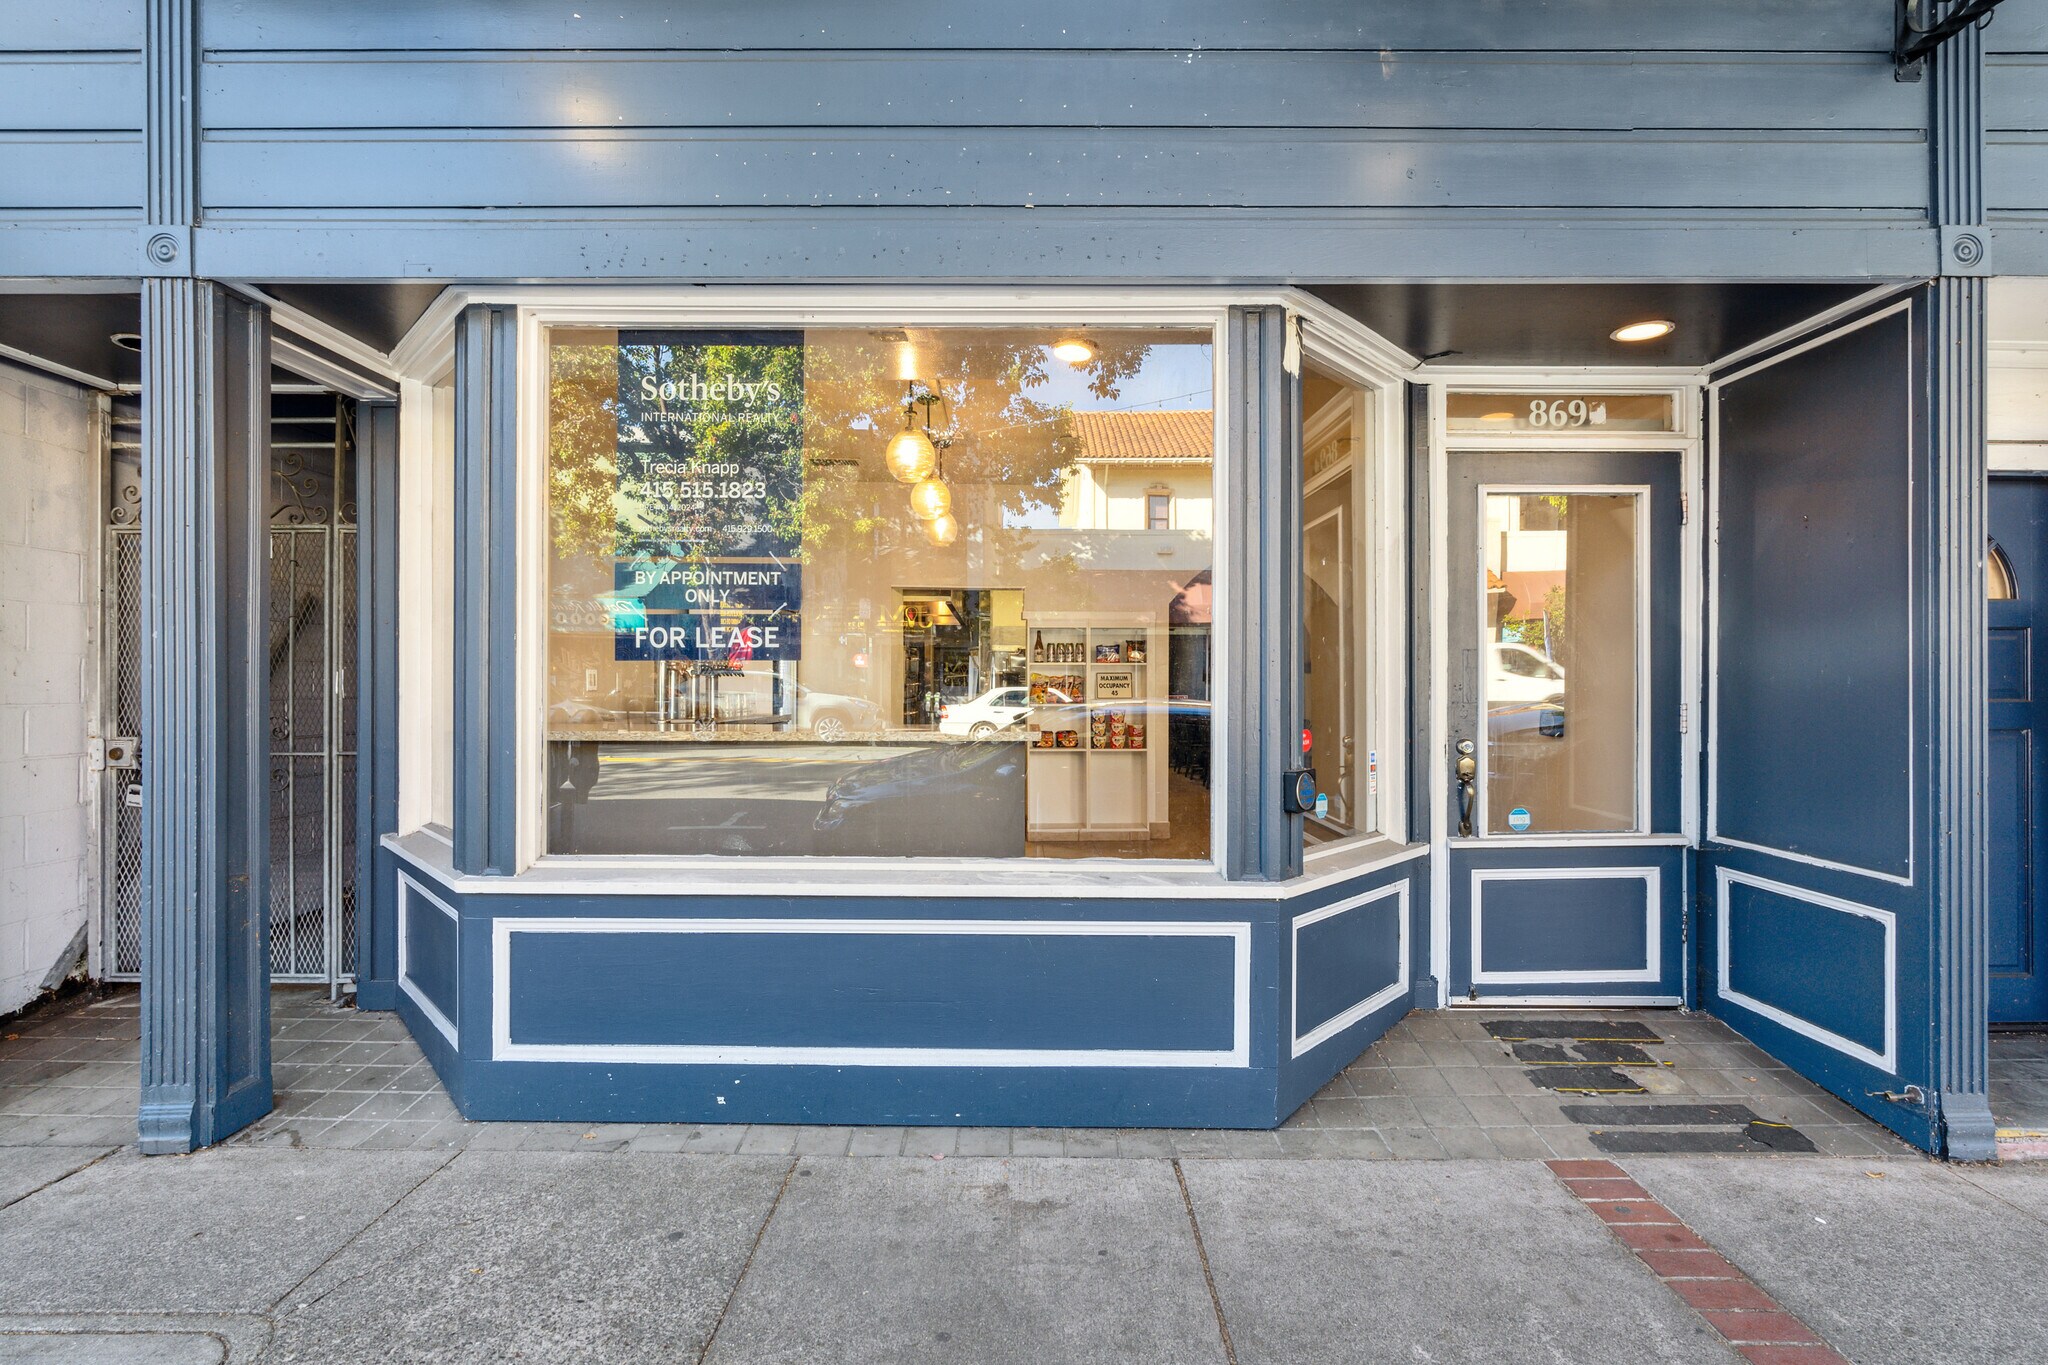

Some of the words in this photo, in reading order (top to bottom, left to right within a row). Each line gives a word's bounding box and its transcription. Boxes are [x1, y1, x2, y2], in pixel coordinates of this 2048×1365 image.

[640, 373, 781, 407] Sotheby's
[641, 412, 735, 422] INTERNATIONAL
[738, 412, 780, 422] REALTY
[1528, 400, 1587, 427] 869
[640, 460, 686, 474] Trecia
[691, 460, 740, 477] Knapp
[640, 482, 766, 499] 415.515.1823
[722, 524, 773, 533] 415.929.1500
[635, 571, 656, 585] BY
[659, 571, 782, 585] APPOINTMENT
[685, 589, 730, 603] ONLY
[635, 627, 685, 648] FOR
[695, 627, 779, 648] LEASE
